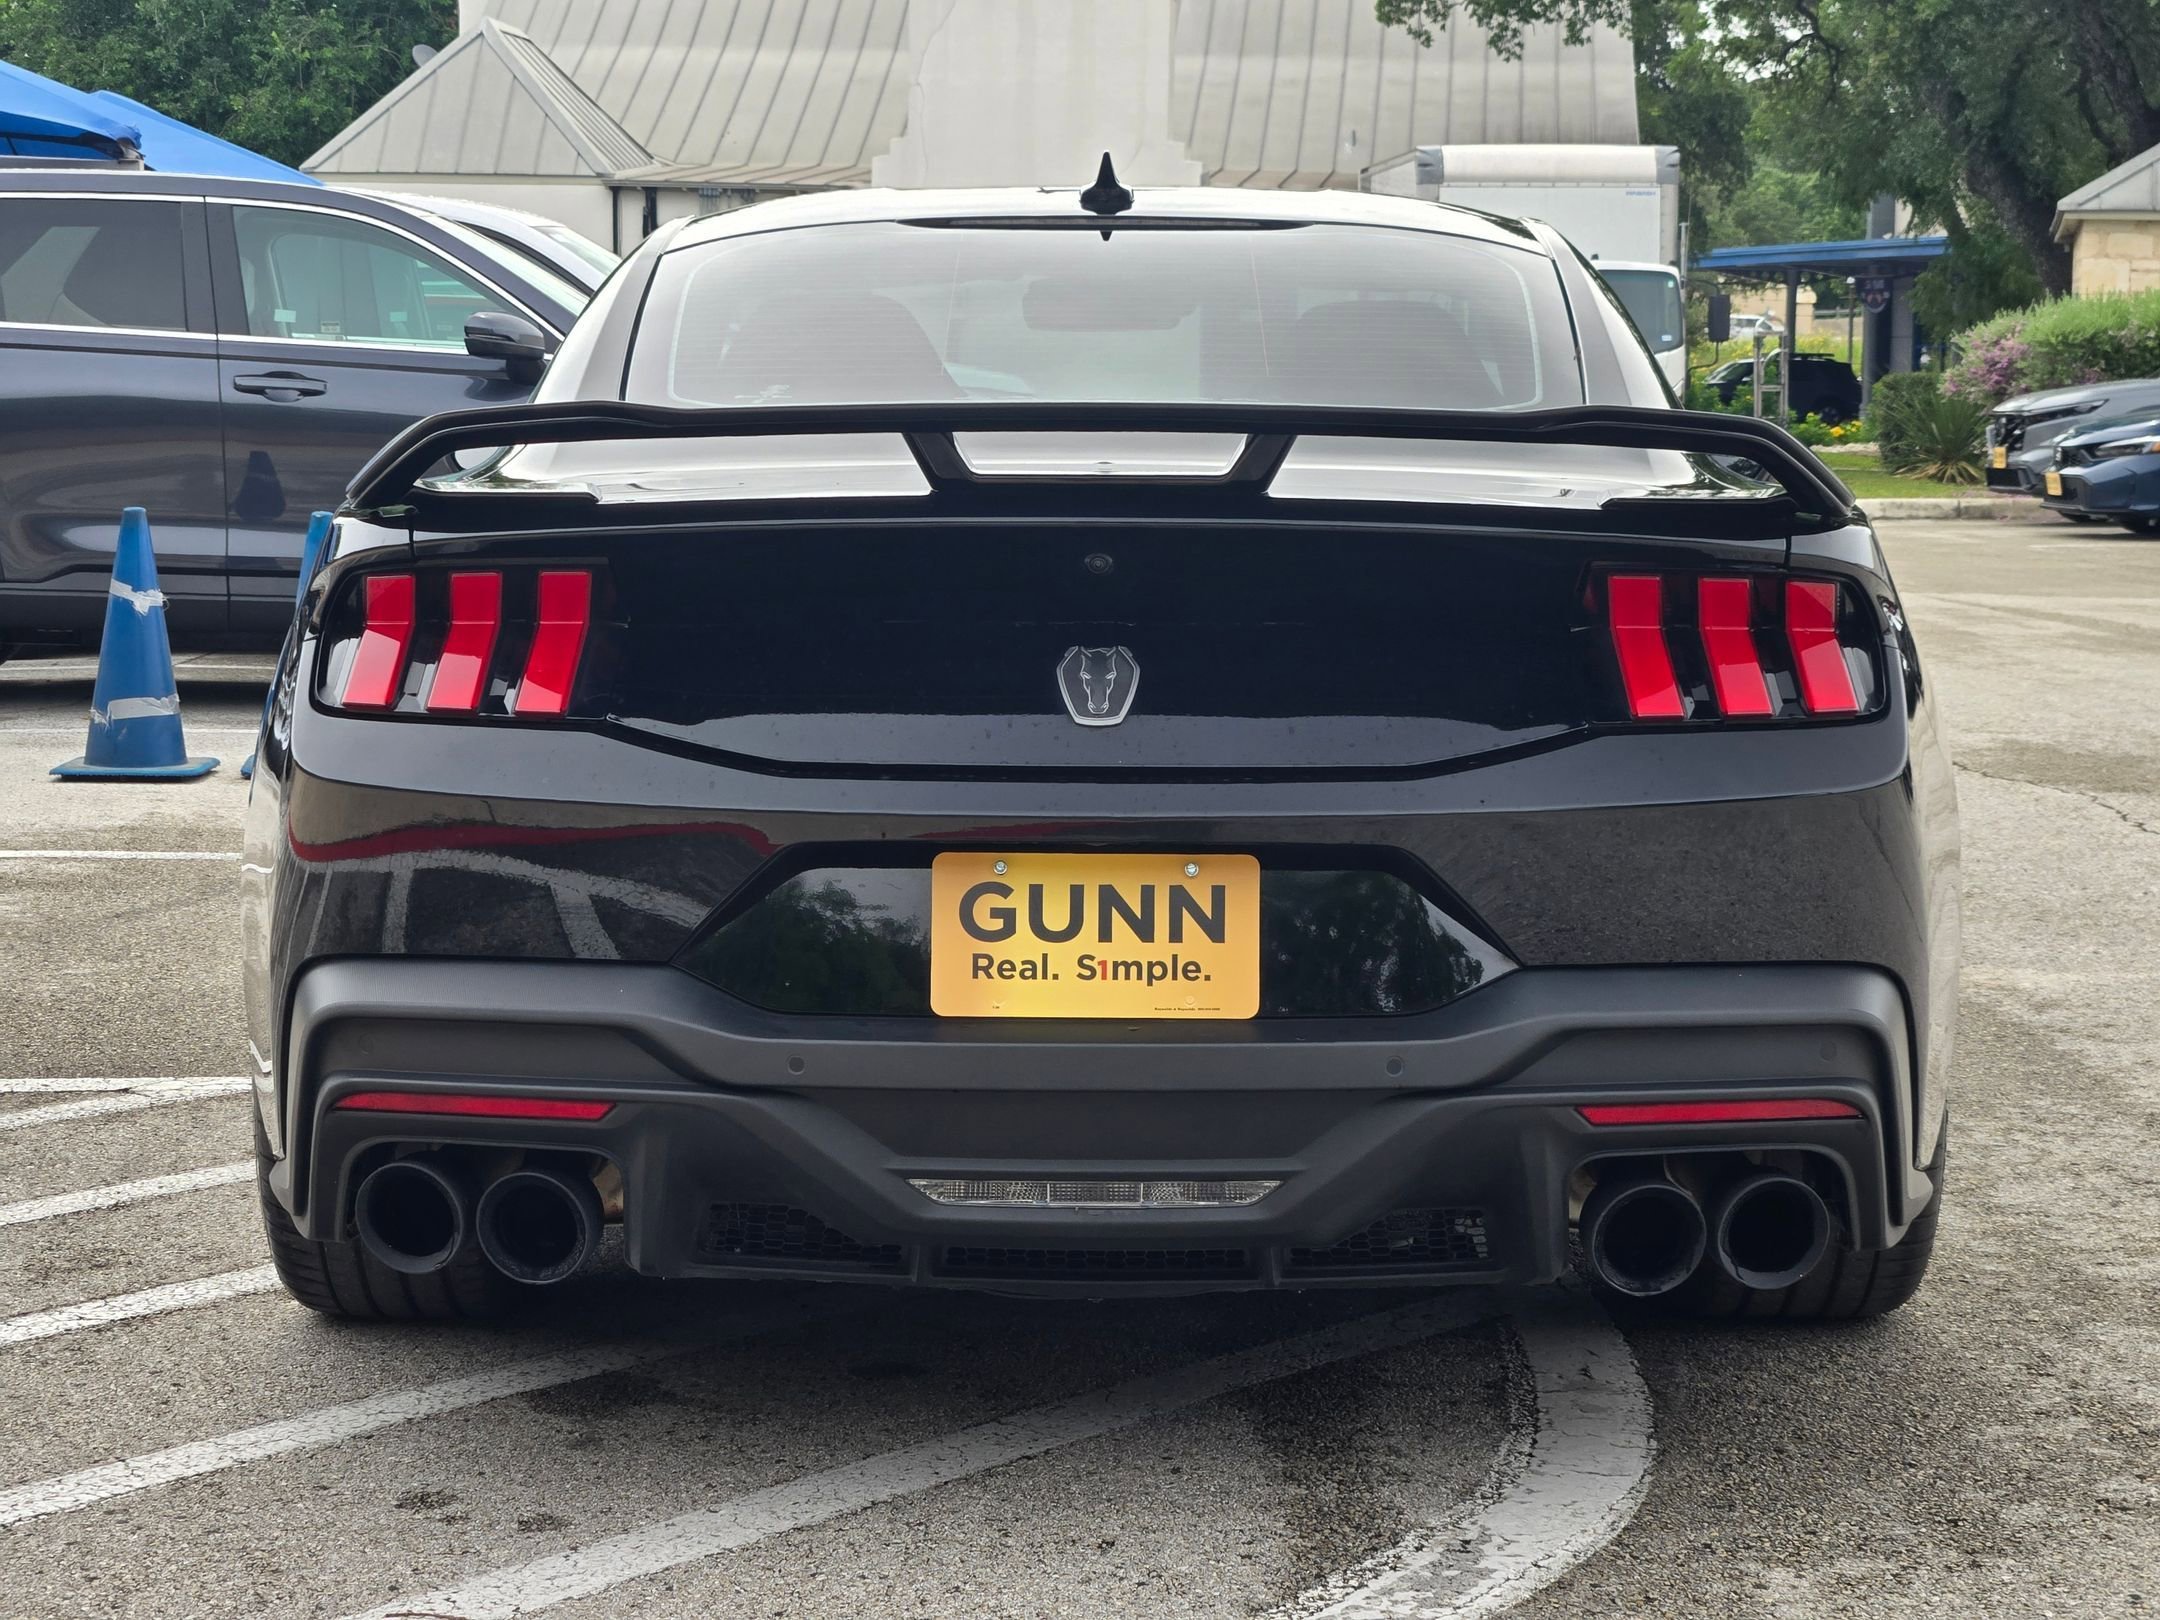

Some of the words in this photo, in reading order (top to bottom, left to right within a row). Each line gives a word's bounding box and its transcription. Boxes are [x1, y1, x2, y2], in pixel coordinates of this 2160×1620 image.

[959, 881, 1226, 943] GUNN
[971, 953, 1059, 980] Real.
[1076, 954, 1211, 987] S1mple.
